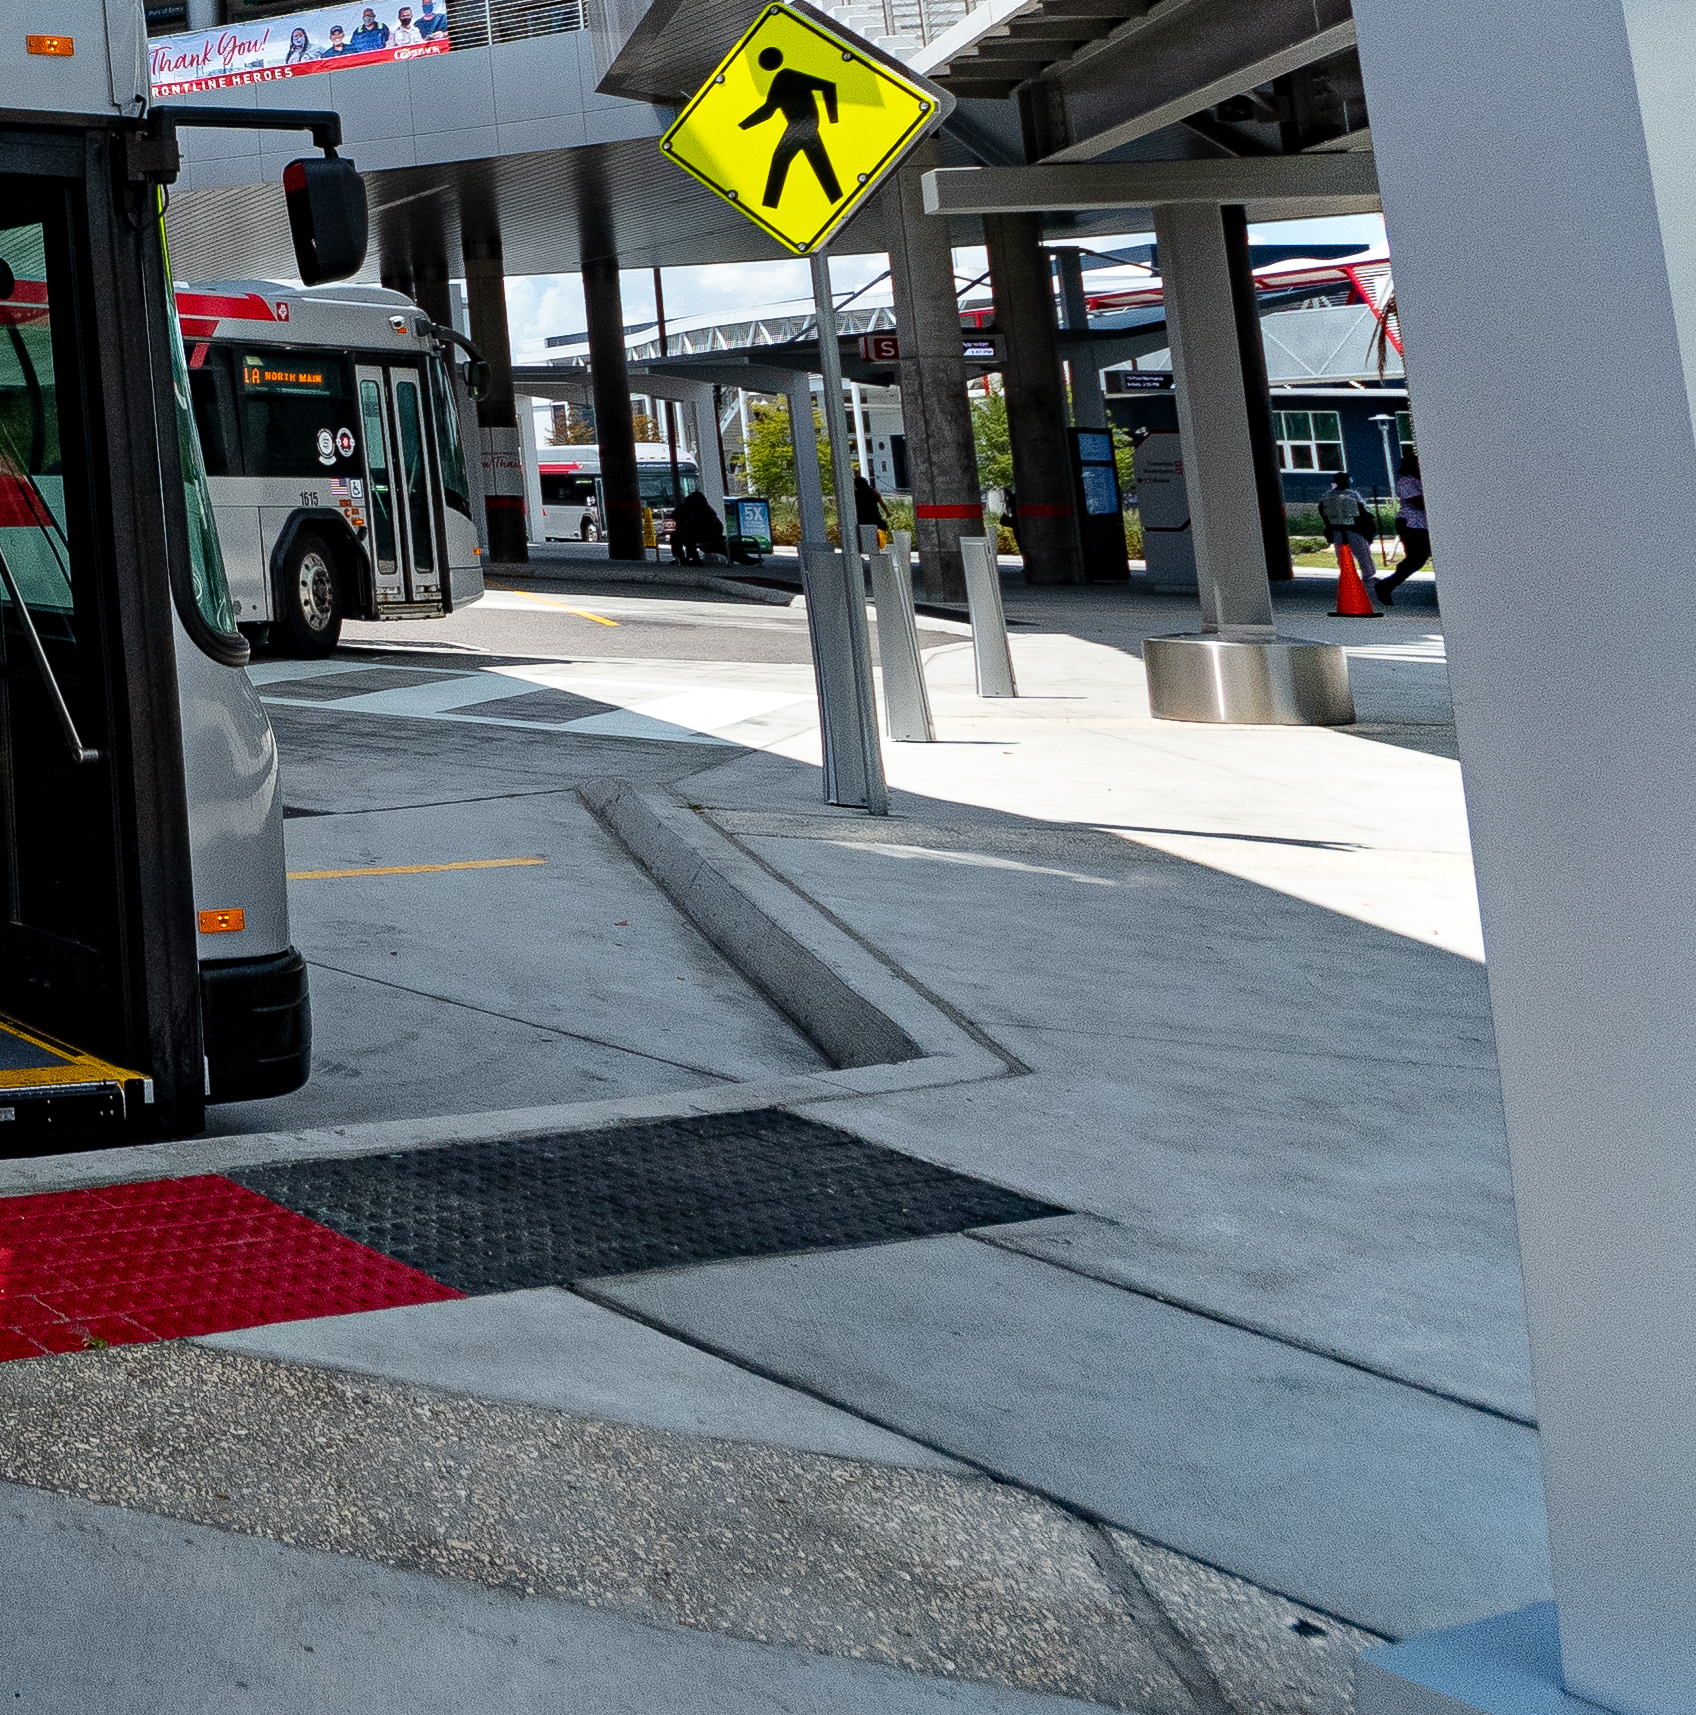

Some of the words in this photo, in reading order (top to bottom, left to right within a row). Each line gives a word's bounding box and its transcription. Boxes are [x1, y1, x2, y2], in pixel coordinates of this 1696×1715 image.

[149, 40, 214, 75] Thank
[218, 28, 270, 66] You!
[151, 77, 227, 97] RONTLINE
[233, 67, 294, 85] HEROES
[880, 341, 895, 357] S
[264, 372, 296, 382] NORTH
[299, 491, 319, 507] 1615
